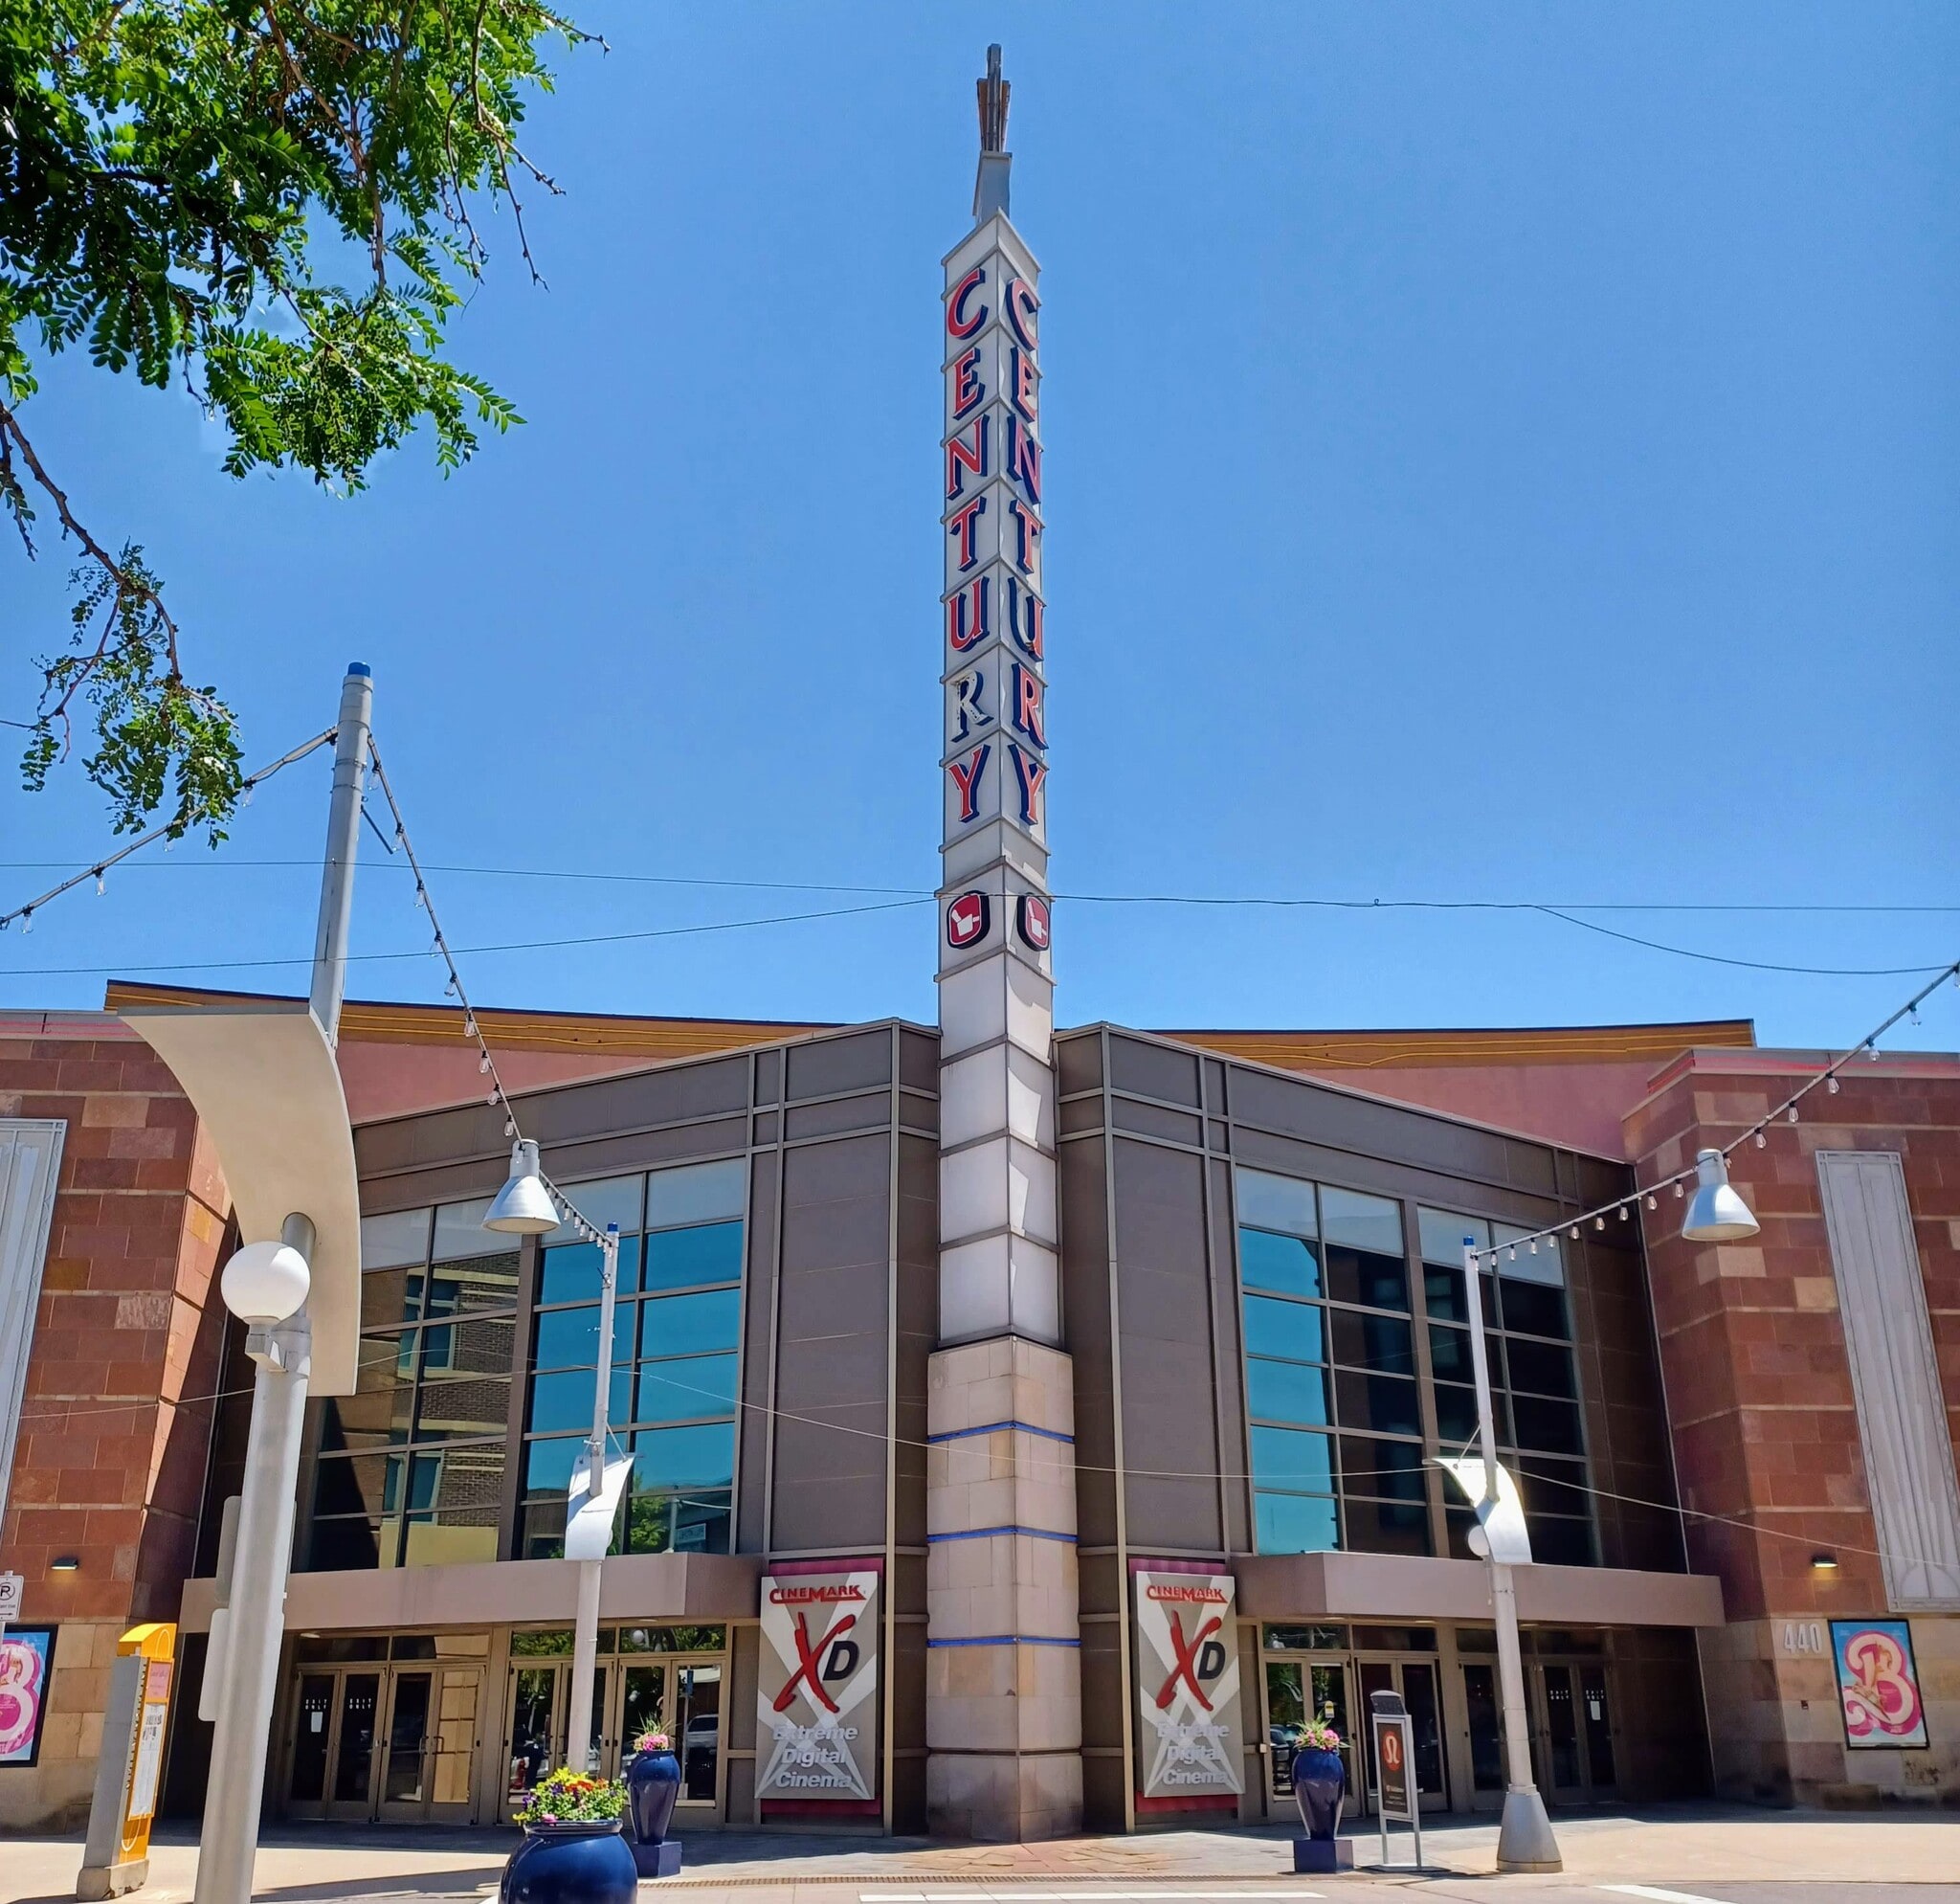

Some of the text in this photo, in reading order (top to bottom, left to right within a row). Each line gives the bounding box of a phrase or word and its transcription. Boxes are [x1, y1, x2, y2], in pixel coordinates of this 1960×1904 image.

[947, 267, 994, 823] CENTURY
[1006, 277, 1049, 825] CENTURY
[769, 1584, 867, 1604] CINEMARK
[1147, 1585, 1228, 1603] CINEMARK
[1784, 1623, 1822, 1654] 440
[772, 1724, 858, 1741] Extreme
[781, 1747, 847, 1768] Digital
[1166, 1744, 1221, 1764] Digital
[775, 1771, 854, 1789] Cinema
[1163, 1768, 1228, 1785] Cinema
